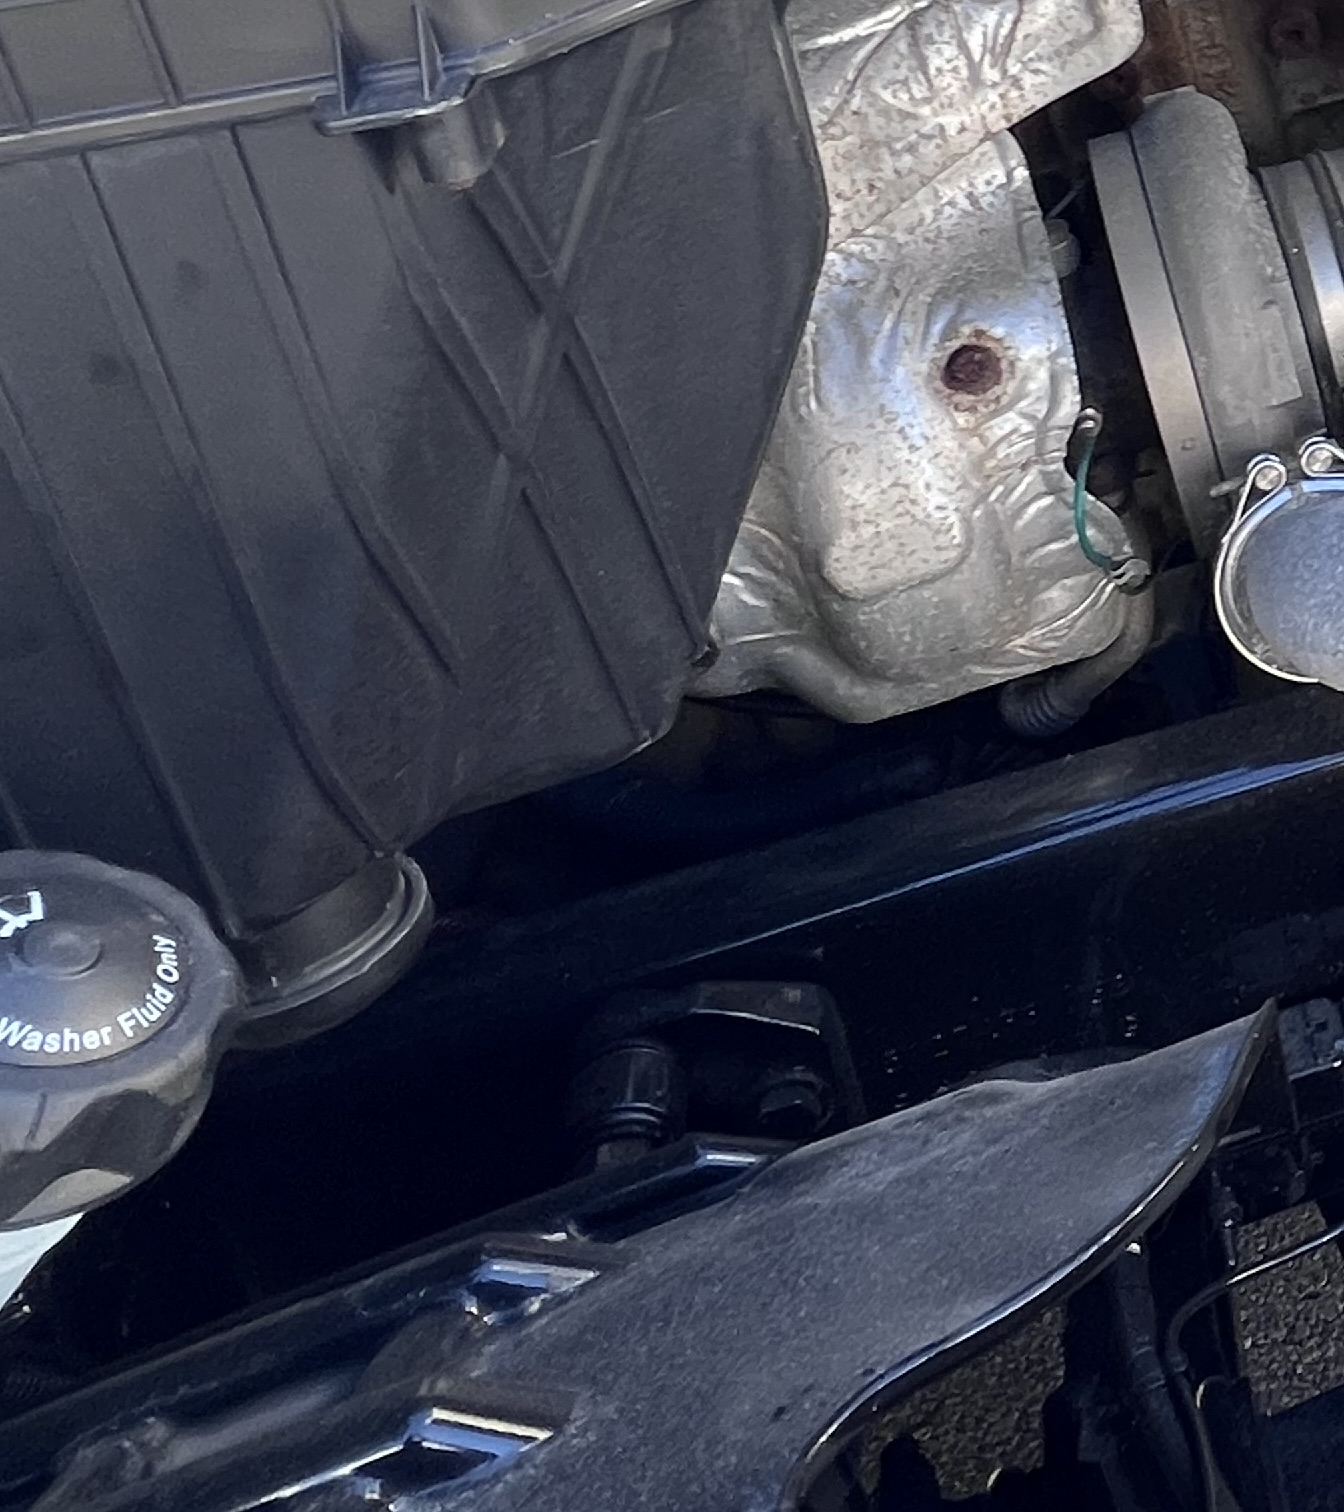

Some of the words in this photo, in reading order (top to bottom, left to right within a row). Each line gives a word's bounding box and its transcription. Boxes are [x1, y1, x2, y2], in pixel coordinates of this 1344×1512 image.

[0, 1016, 112, 1053] Washer
[116, 982, 174, 1037] Fluid
[152, 934, 180, 984] Only
